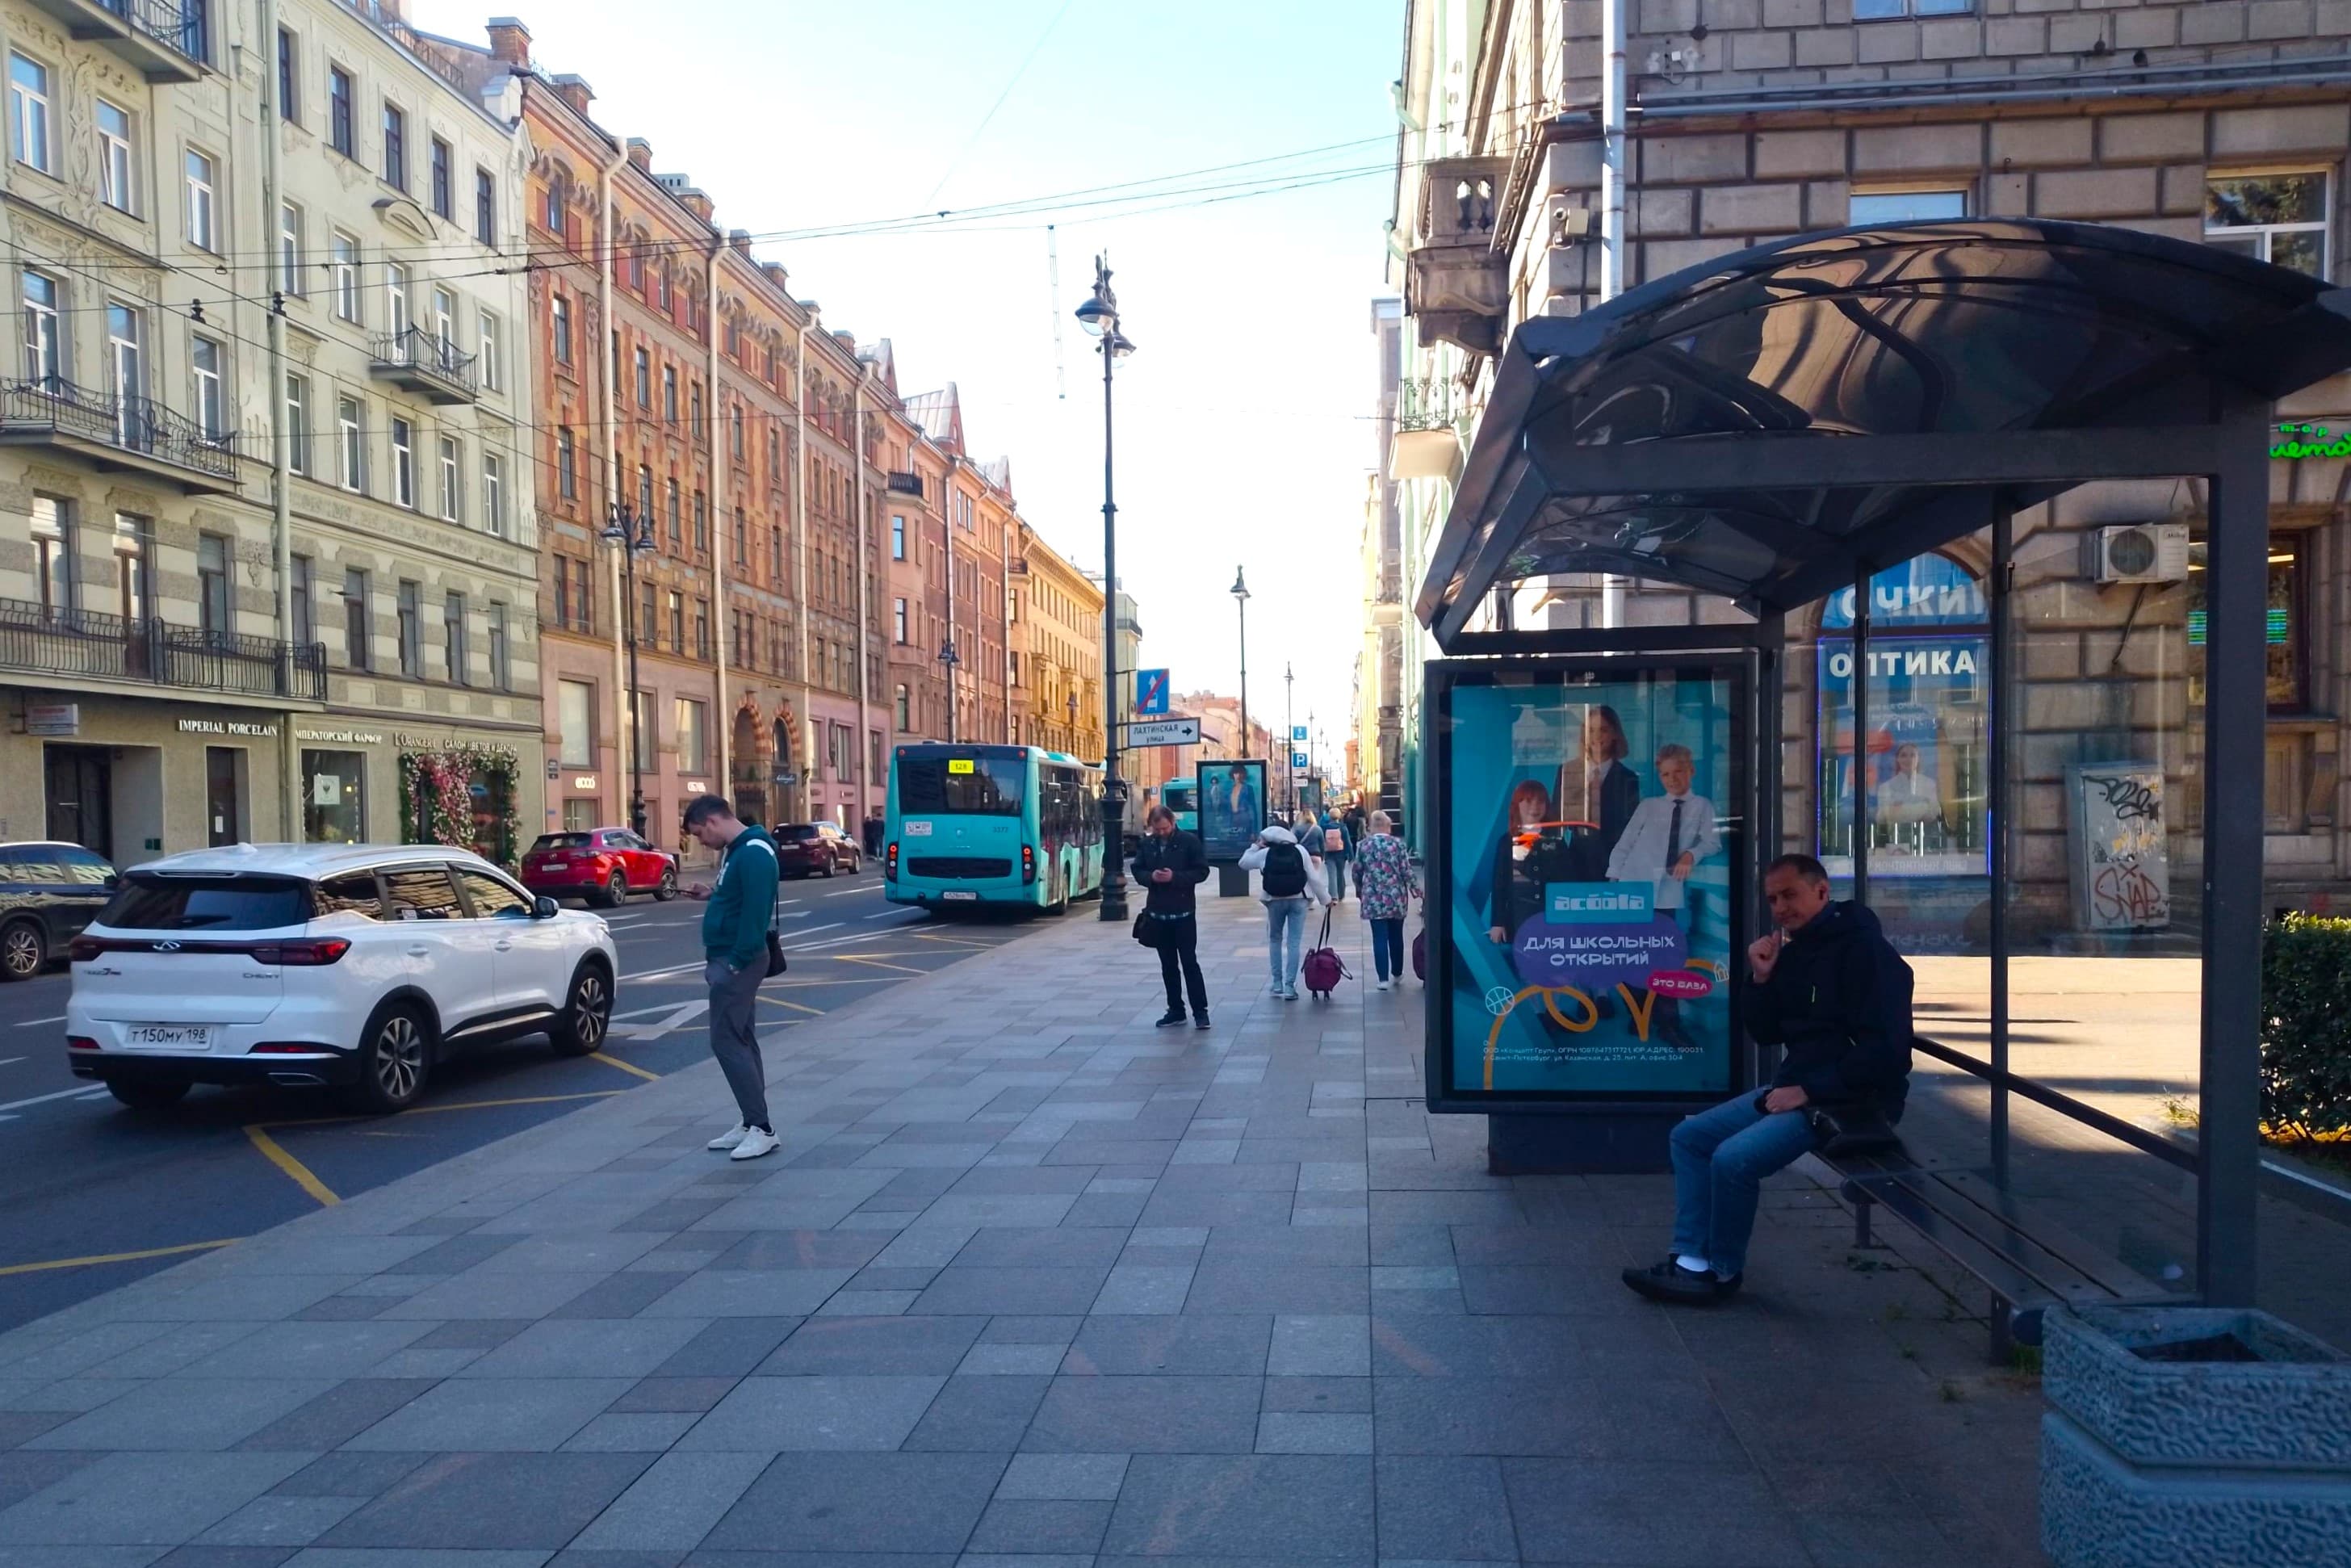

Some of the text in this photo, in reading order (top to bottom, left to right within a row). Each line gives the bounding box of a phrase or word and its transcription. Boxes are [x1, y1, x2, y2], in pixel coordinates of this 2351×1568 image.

[178, 719, 278, 736] IMPERIAL PORCELAIN
[1134, 723, 1179, 735] ЛАХТИНСКАЯ
[295, 729, 382, 744] МПЕРАТОРСКИЙ ФАРФОР
[445, 739, 466, 750] САЛОН
[1523, 936, 1675, 951] ДЛЯ ШКОЛЬНЫХ
[1550, 950, 1649, 966] ОТКРЫТИЙ
[1653, 978, 1708, 991] ЭТО БАЗА
[132, 1029, 206, 1042] Т150МУ 198
